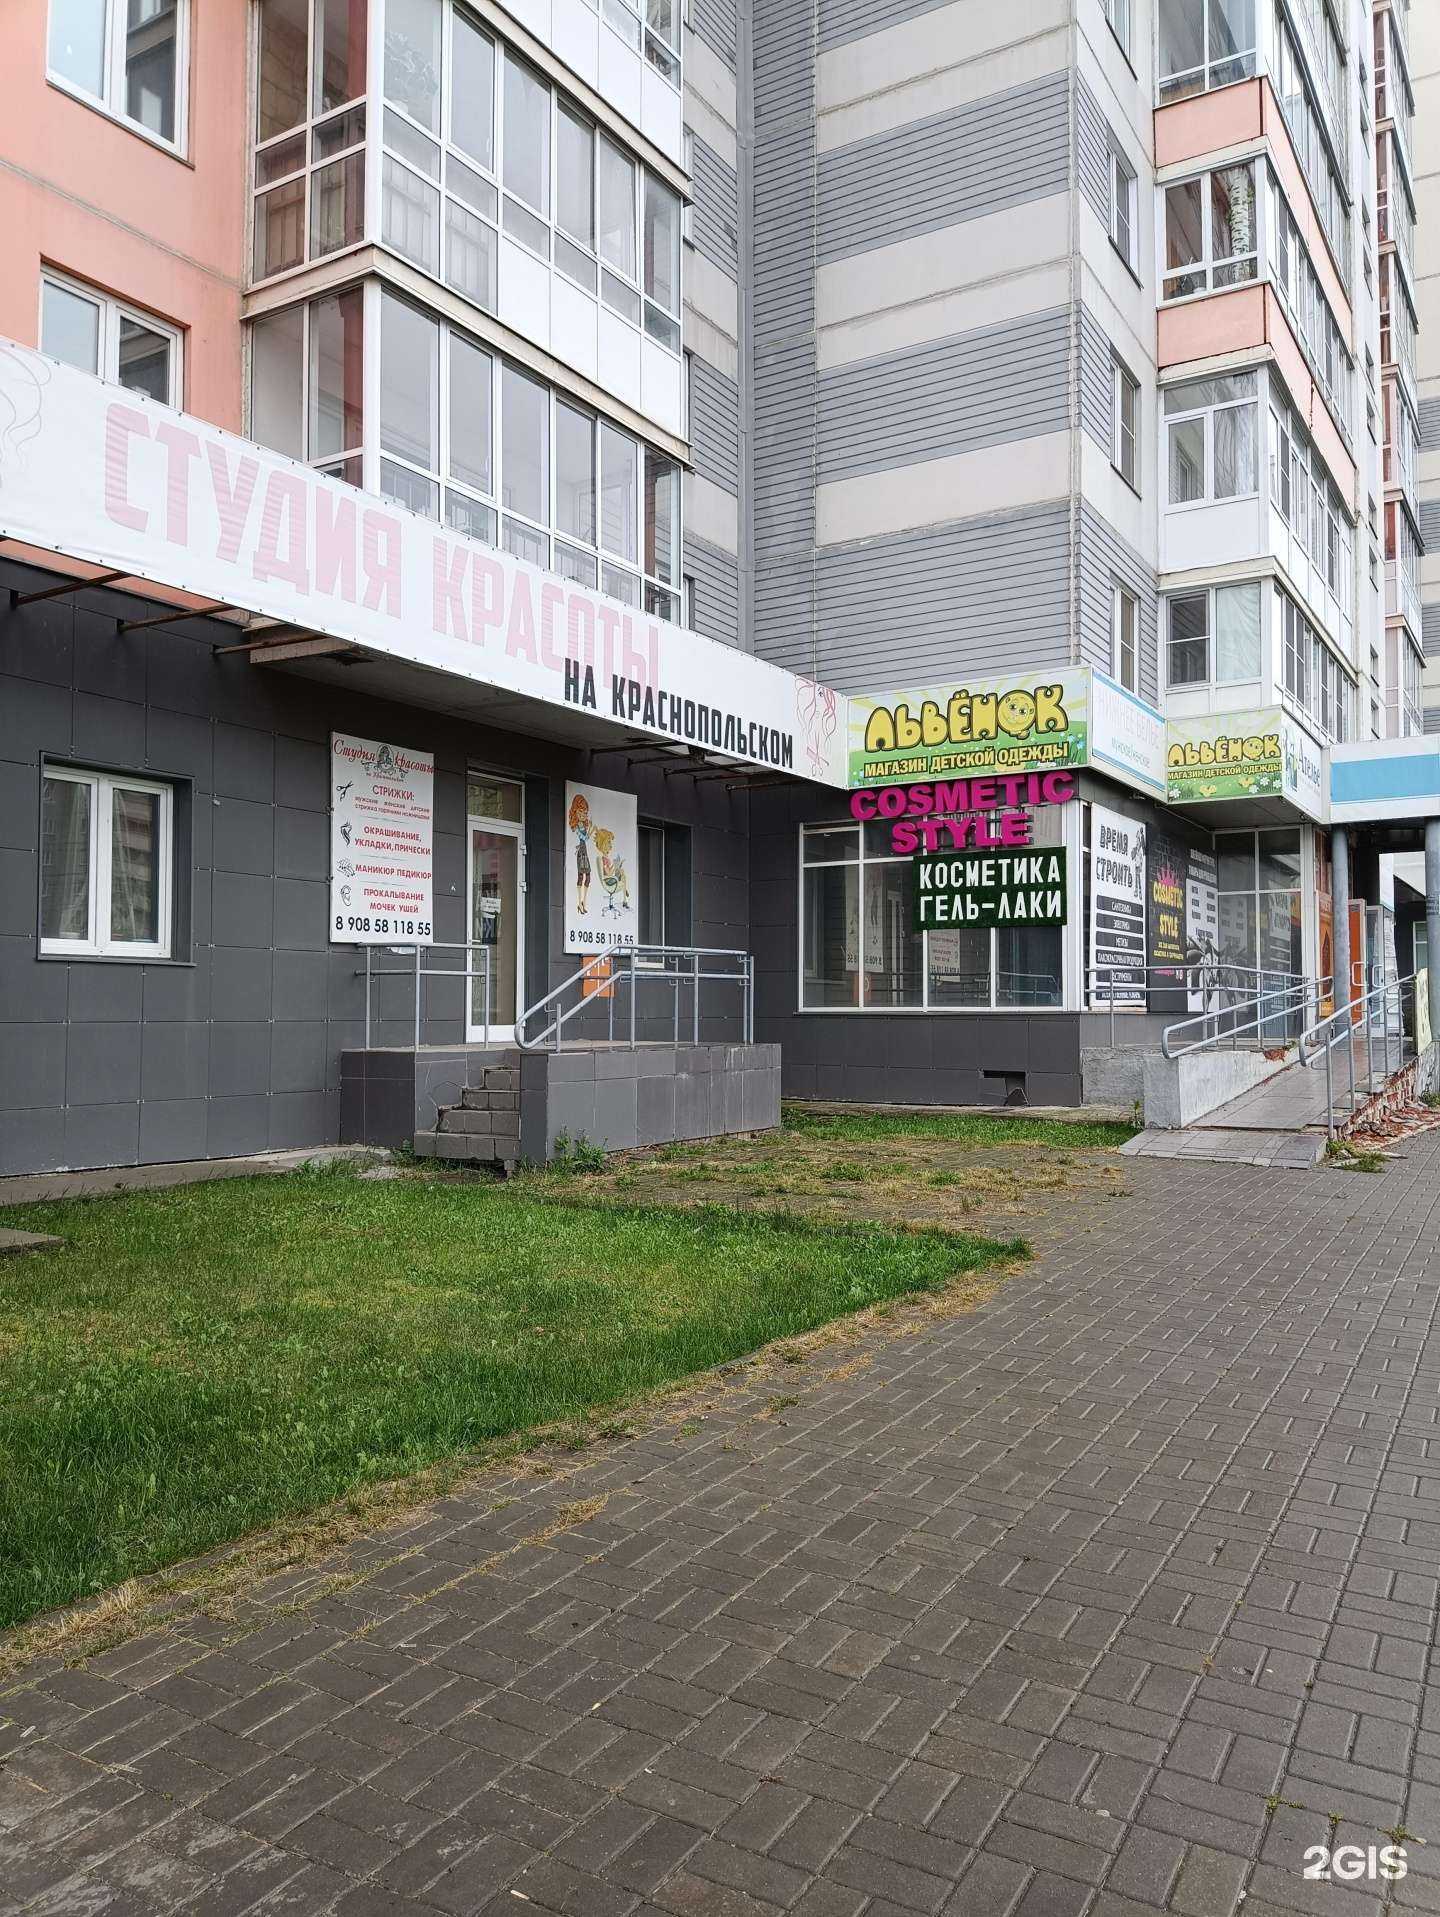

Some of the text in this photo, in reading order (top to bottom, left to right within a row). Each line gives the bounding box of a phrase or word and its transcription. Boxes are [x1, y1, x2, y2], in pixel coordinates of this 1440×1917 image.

[104, 402, 660, 703] СТУДИЯ КРАСОТЫ
[564, 657, 793, 769] НА КРАСНОПОЛЬСКОМ
[865, 684, 1069, 753] ЛЬВЁНОК
[334, 739, 376, 762] Студия
[864, 741, 1069, 778] МАГАЗИН ДЕТСКОЙ ОДЕЖДЫ
[1168, 734, 1281, 767] ЛЬВЁНОК
[1168, 763, 1281, 780] МАГАЗИН ДЕТСКОЙ ОДЕЖДЫ
[372, 785, 415, 801] СТРИЖКИ:
[851, 771, 1075, 820] COSMETIC
[363, 826, 422, 842] ОКРАШИВАНИЕ,
[892, 812, 1030, 853] STYLE
[1100, 824, 1129, 856] ВРЕМЯ
[394, 843, 431, 855] ПРИЧЕСКИ
[355, 864, 432, 880] МАНИКЮР ПЕДИКЮР
[919, 855, 1061, 890] КОСМЕТИКА
[1096, 856, 1133, 888] СТРОИТЬ
[363, 888, 425, 901] ПРОКАЛЫВАНИЕ
[369, 902, 419, 913] МОЧЕК УШЕЙ
[919, 889, 1062, 922] ГЕЛЬ-ЛАКИ
[1153, 881, 1184, 908] COSMETIC
[335, 915, 431, 935] 8 908 58 118 55
[569, 930, 576, 942] 8
[577, 930, 594, 944] 908
[595, 932, 606, 944] 58
[608, 933, 623, 945] 118
[1159, 914, 1179, 938] STYLE
